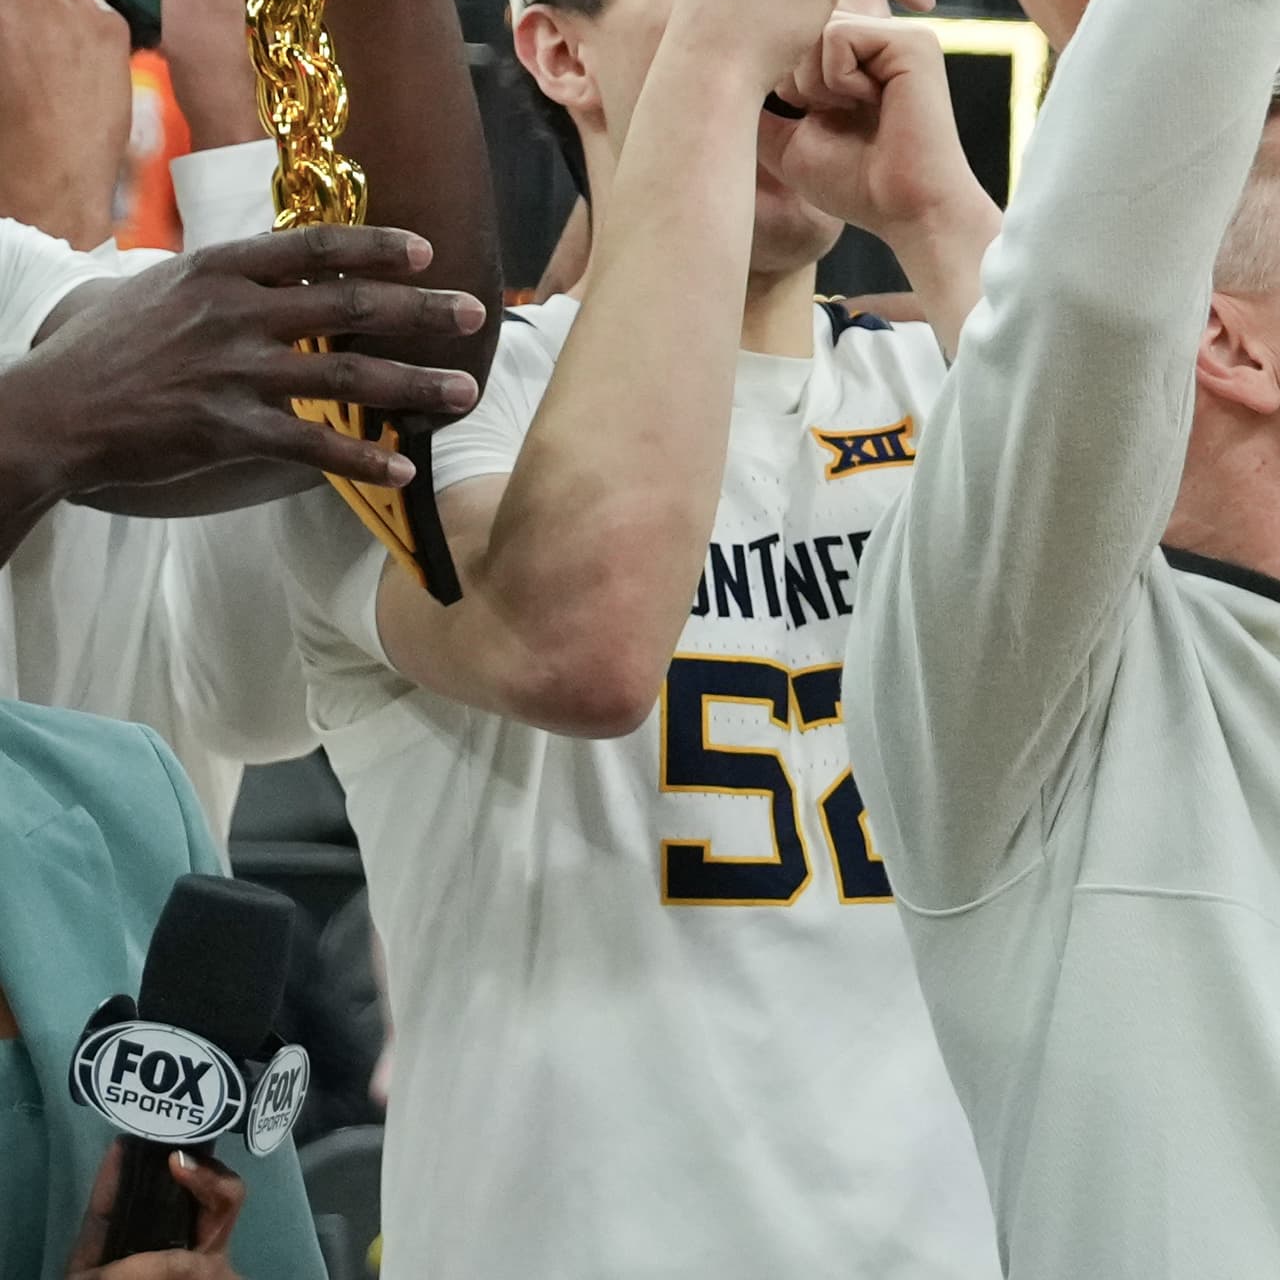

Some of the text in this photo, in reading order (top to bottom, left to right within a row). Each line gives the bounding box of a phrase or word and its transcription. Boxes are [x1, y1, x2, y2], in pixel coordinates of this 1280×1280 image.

[110, 1039, 214, 1107] FOX
[263, 1064, 302, 1116] FOX
[105, 1085, 205, 1126] SPORTS
[255, 1111, 291, 1134] SPORTS
